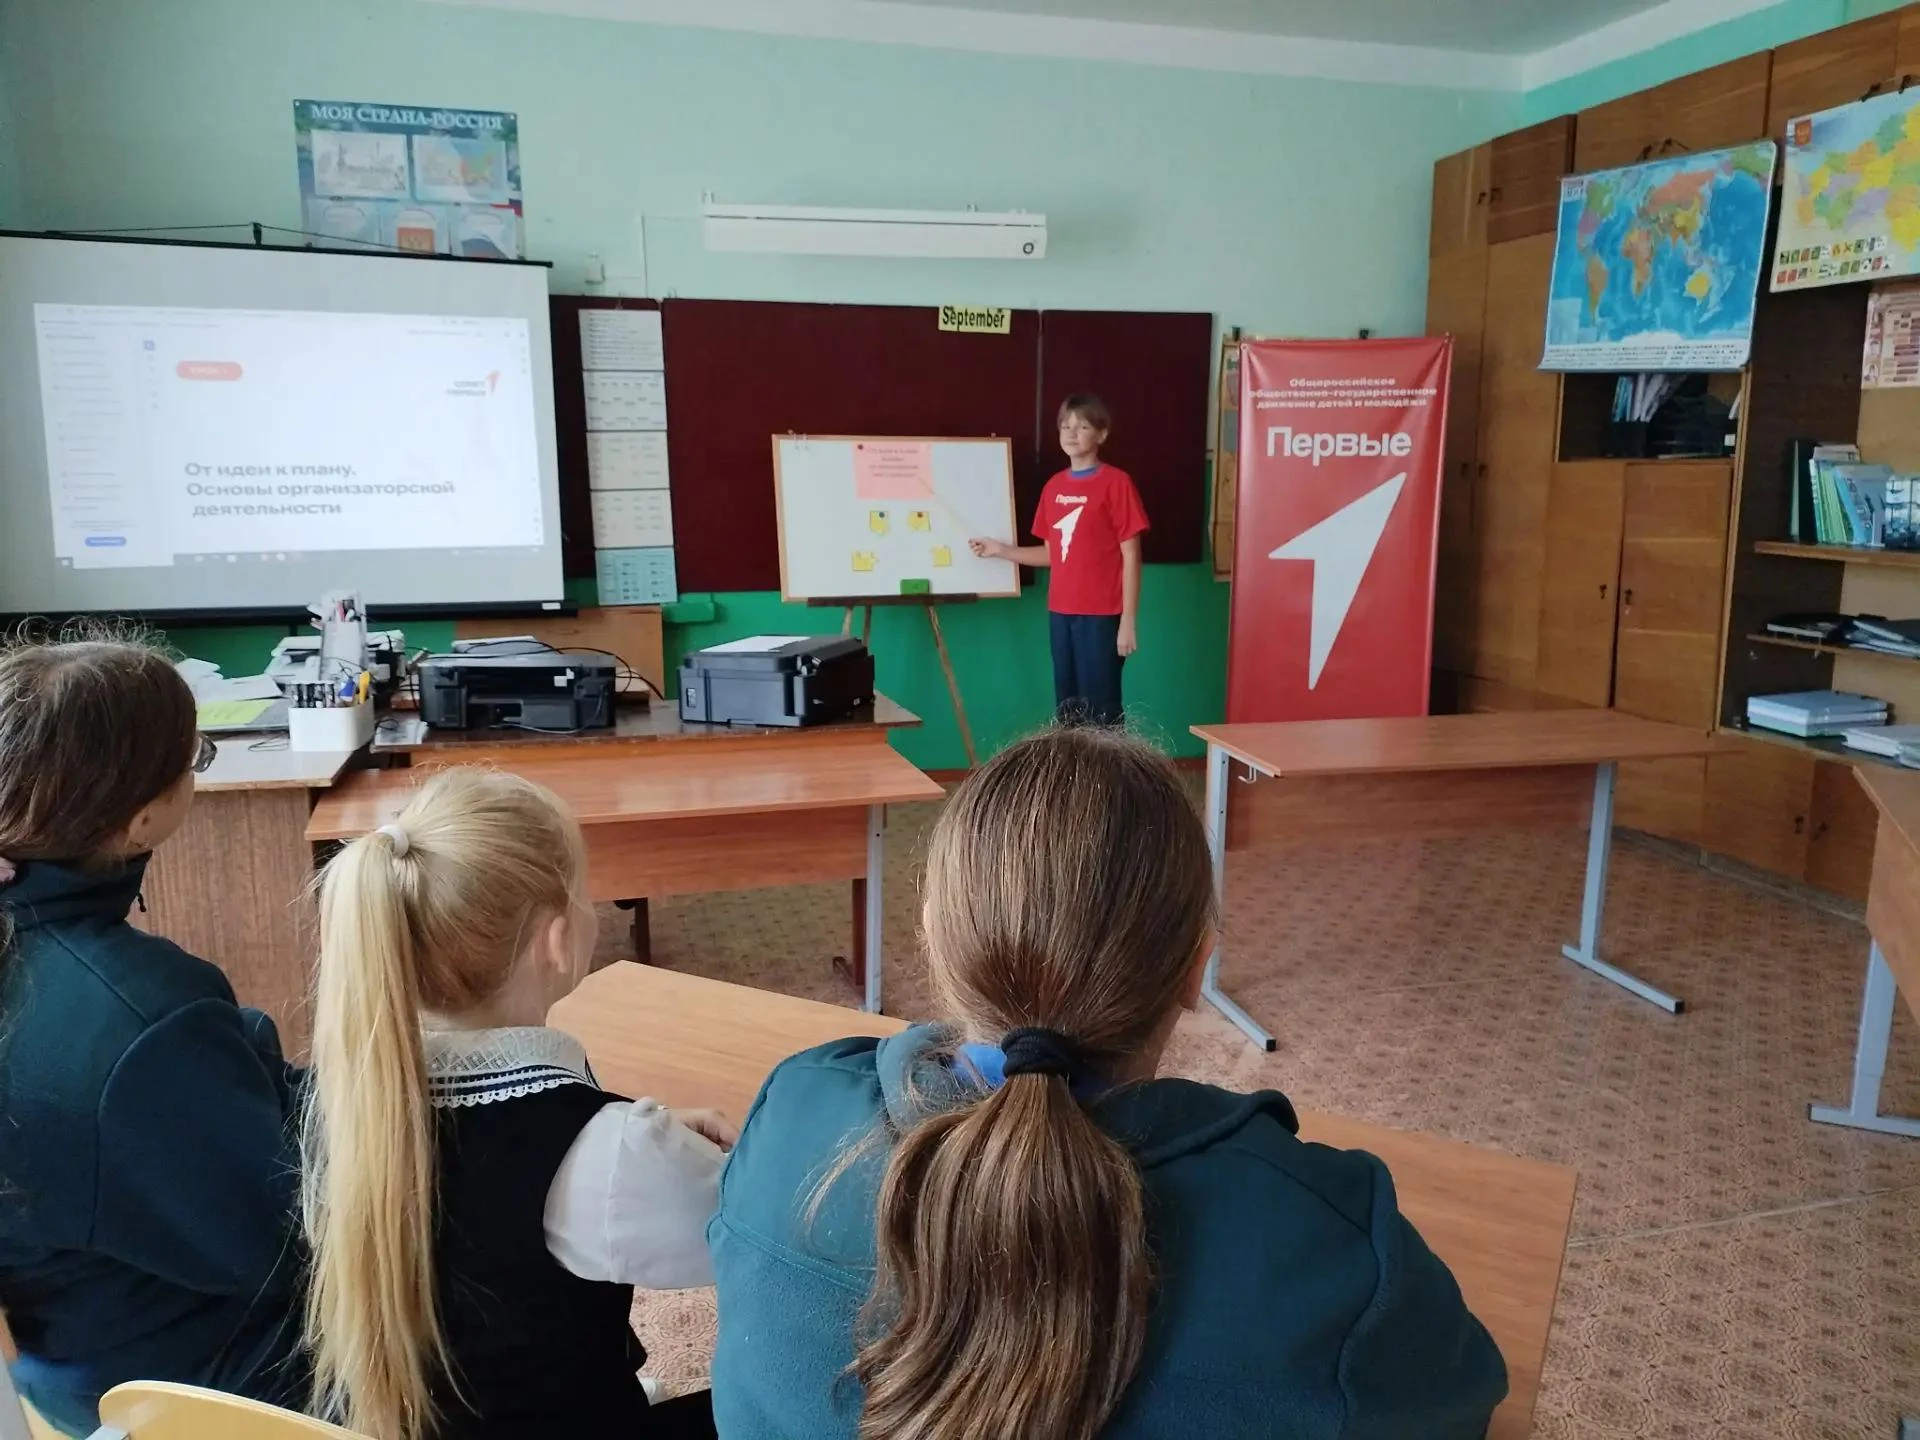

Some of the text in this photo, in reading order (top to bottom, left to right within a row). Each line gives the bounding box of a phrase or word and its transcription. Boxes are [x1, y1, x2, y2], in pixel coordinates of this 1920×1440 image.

[311, 104, 353, 121] МОЯ
[942, 305, 1005, 331] September
[1289, 377, 1396, 388] Общероссийское
[1267, 426, 1413, 467] Первые
[184, 462, 213, 477] От
[276, 465, 288, 476] к
[291, 464, 357, 478] плану.
[186, 480, 456, 497] Основы организаторской
[192, 503, 342, 519] деятельности
